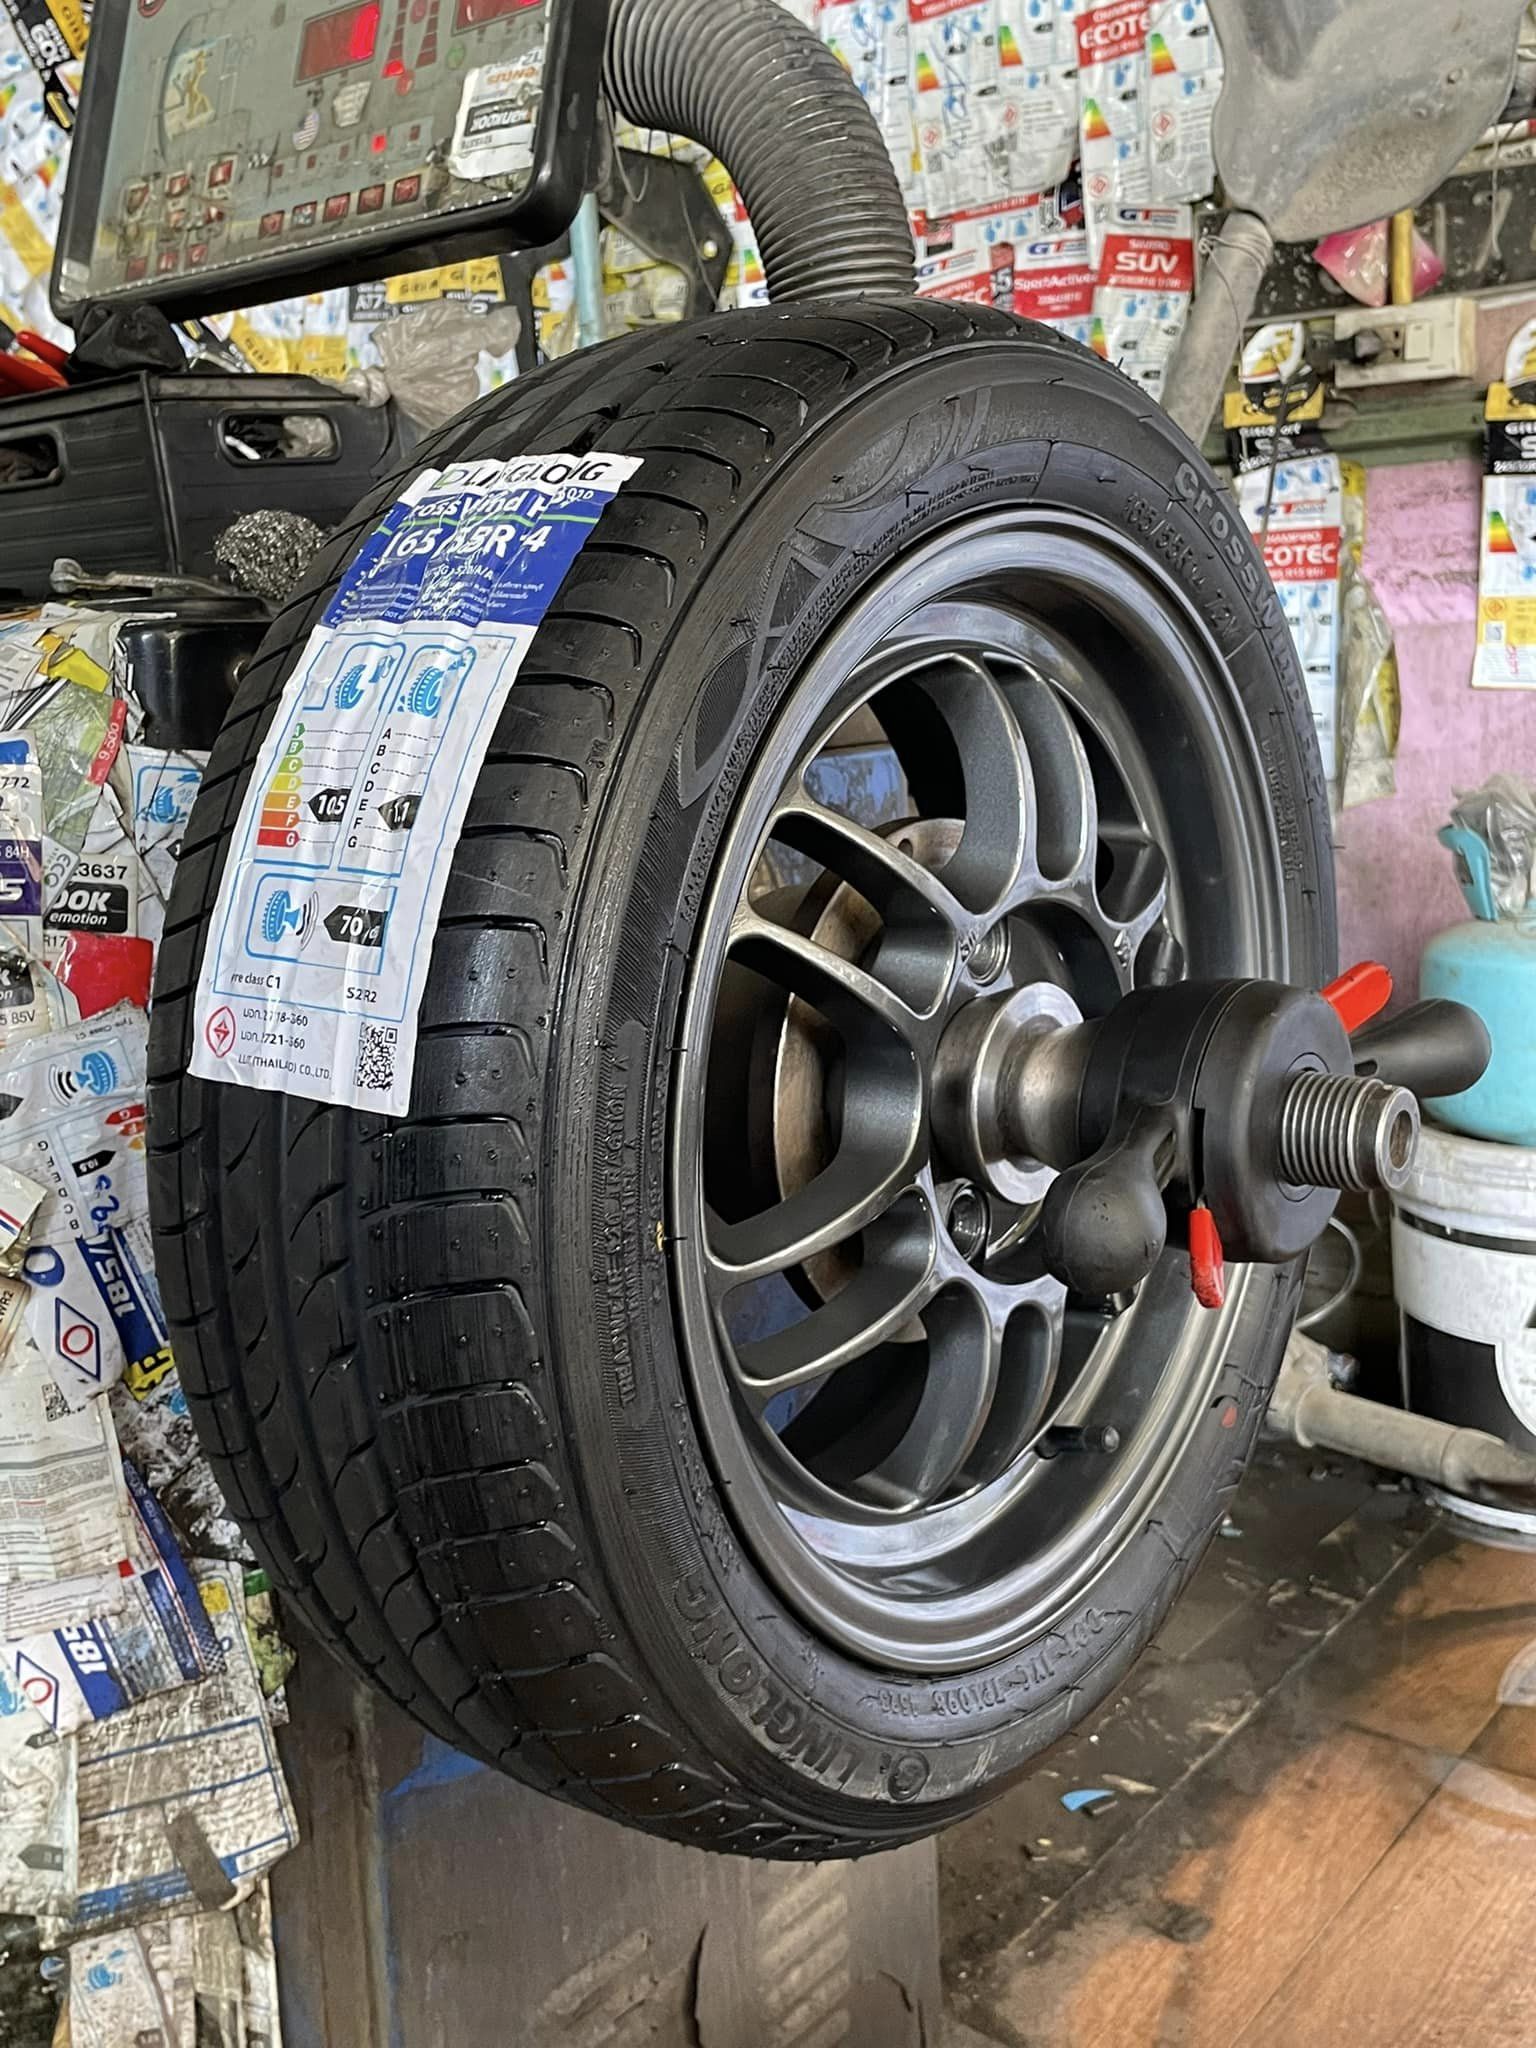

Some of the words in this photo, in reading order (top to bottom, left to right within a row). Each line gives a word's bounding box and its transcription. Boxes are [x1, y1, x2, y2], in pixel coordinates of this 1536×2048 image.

[1115, 252, 1178, 273] SUV
[382, 728, 392, 740] A
[376, 744, 386, 756] B
[289, 759, 298, 772] C
[370, 762, 381, 775] C
[364, 781, 374, 793] D
[286, 795, 296, 809] E
[359, 798, 368, 811] E
[285, 814, 295, 827] F
[354, 817, 363, 829] F
[285, 831, 296, 845] G
[348, 836, 358, 848] G
[50, 911, 107, 926] emotion
[340, 915, 363, 937] 70
[266, 975, 281, 989] C1
